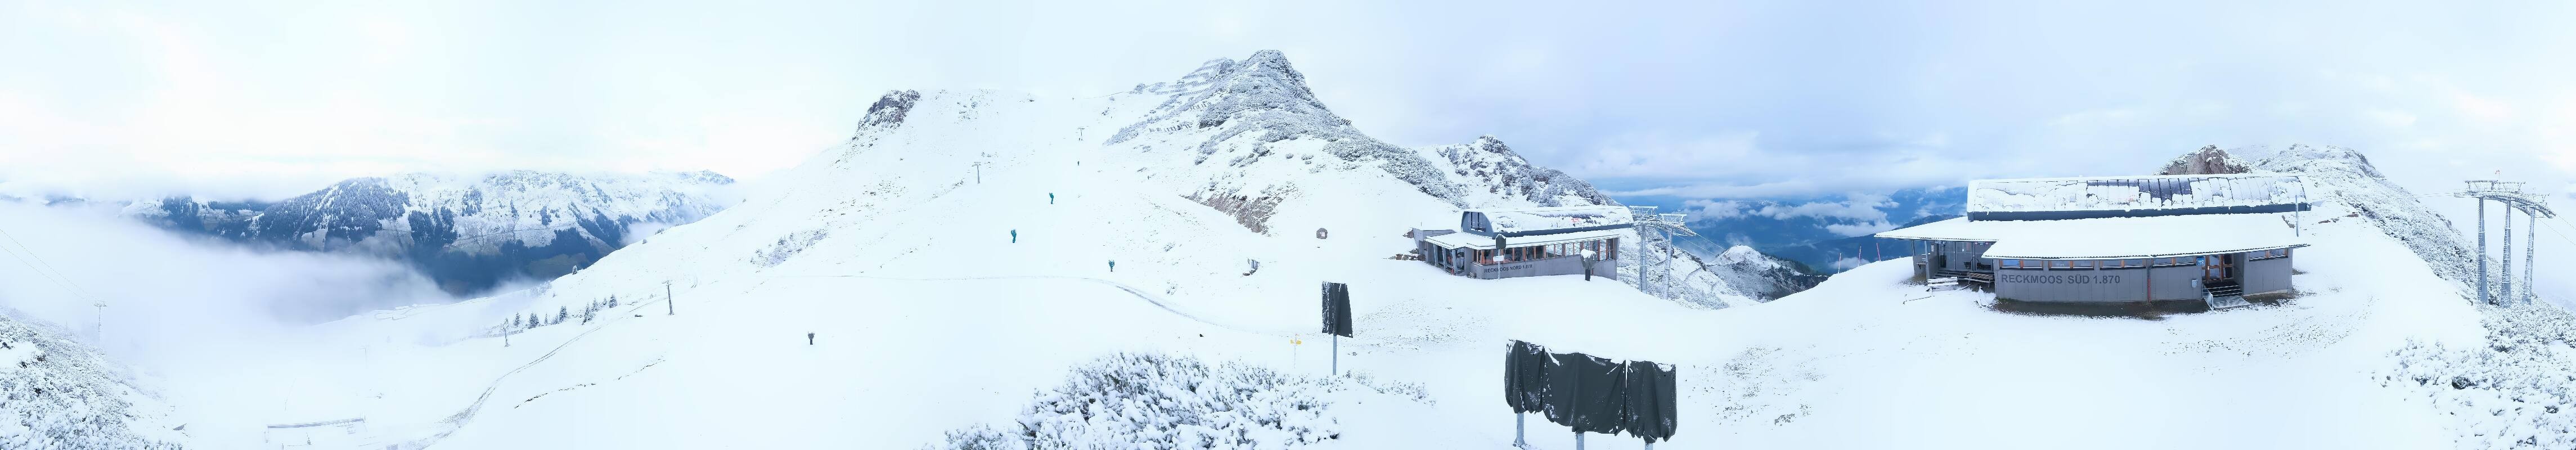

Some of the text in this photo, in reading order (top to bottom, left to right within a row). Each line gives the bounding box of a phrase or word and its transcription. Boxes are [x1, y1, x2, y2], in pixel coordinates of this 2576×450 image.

[2001, 274, 2120, 284] RECKMOOS SÜD 1.870
